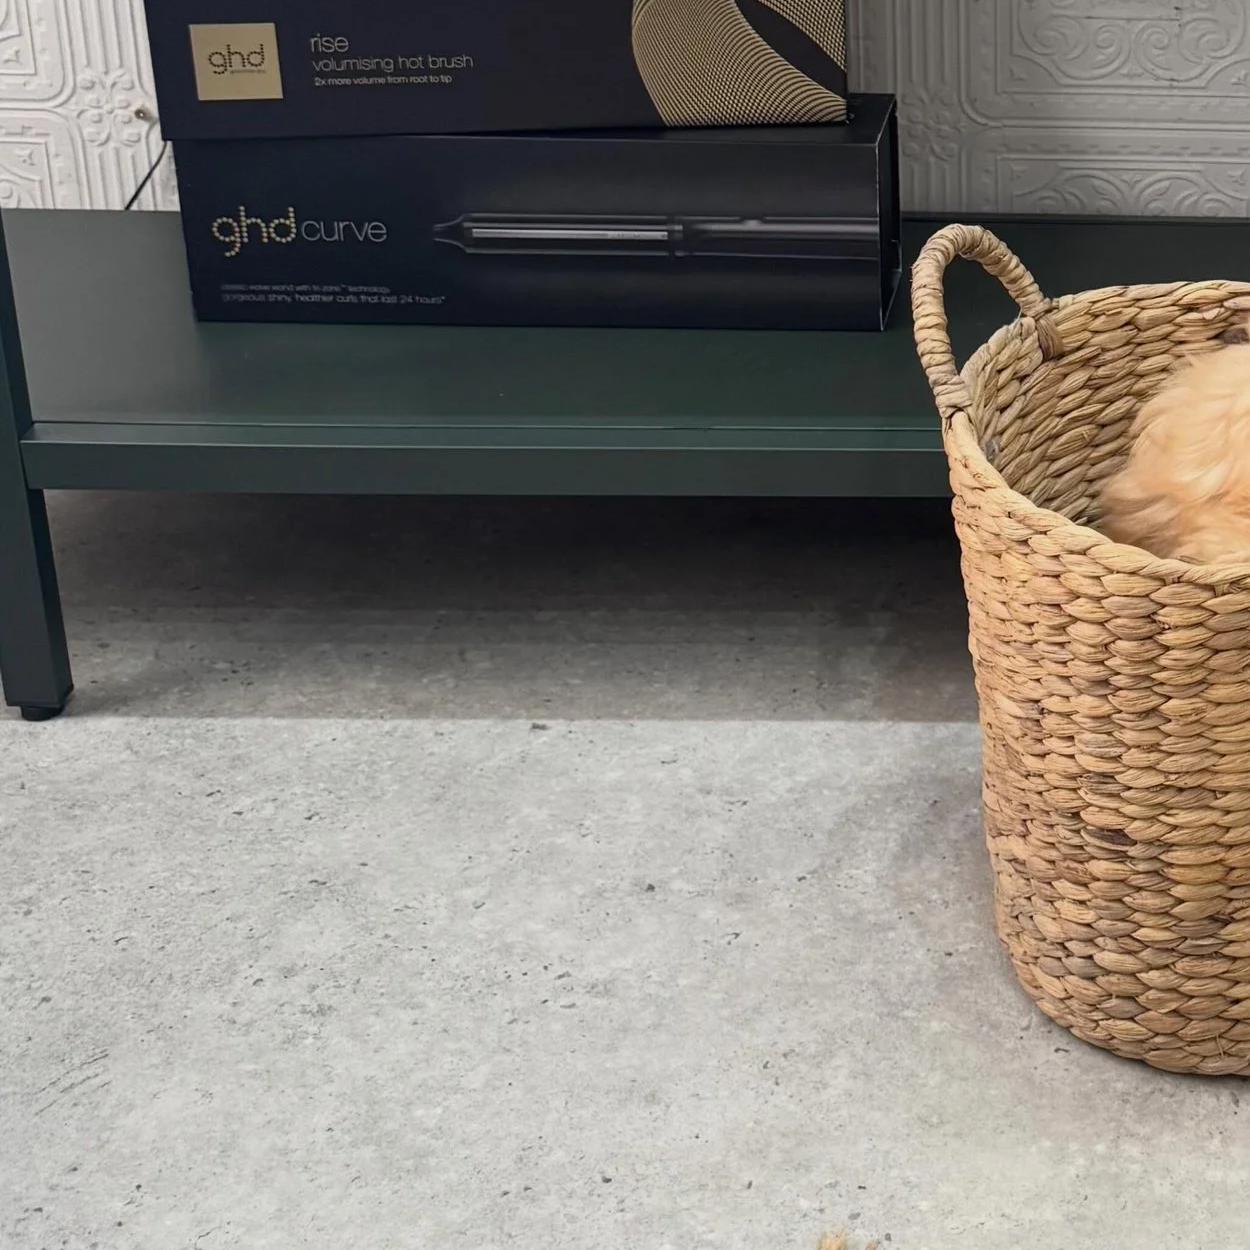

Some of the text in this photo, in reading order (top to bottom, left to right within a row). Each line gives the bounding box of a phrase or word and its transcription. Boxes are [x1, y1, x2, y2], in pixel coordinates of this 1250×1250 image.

[310, 33, 349, 53] rise
[208, 43, 265, 75] ghd
[312, 54, 474, 73] volumising hot brush
[314, 75, 453, 86] 2x more volume from root to tip
[211, 205, 388, 257] ghd curve
